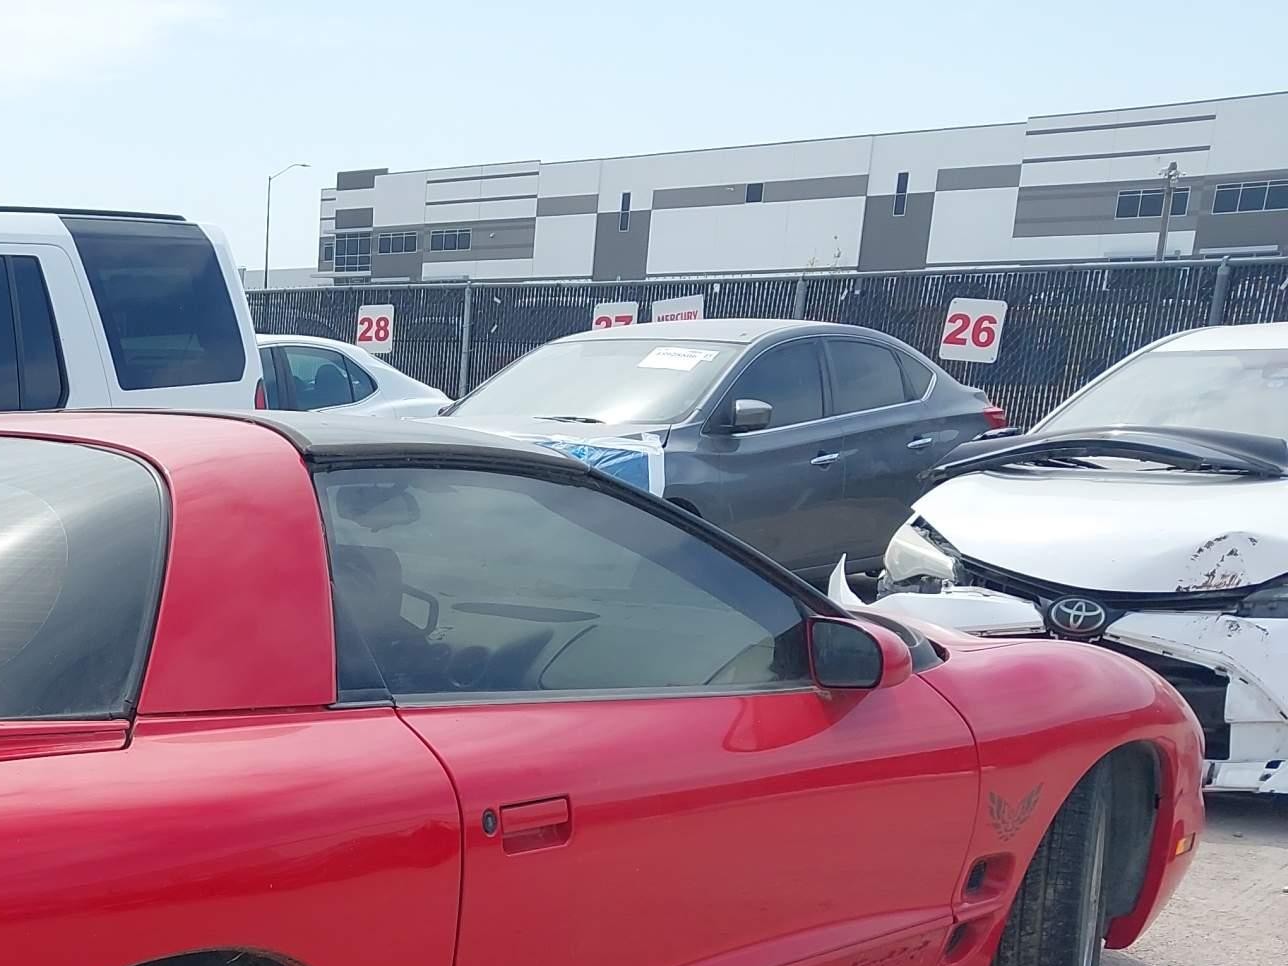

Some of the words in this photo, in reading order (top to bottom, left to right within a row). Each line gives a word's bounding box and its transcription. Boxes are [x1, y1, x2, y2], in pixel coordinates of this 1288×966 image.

[358, 316, 390, 342] 28
[657, 309, 698, 323] MERCURY
[943, 313, 997, 347] 26
